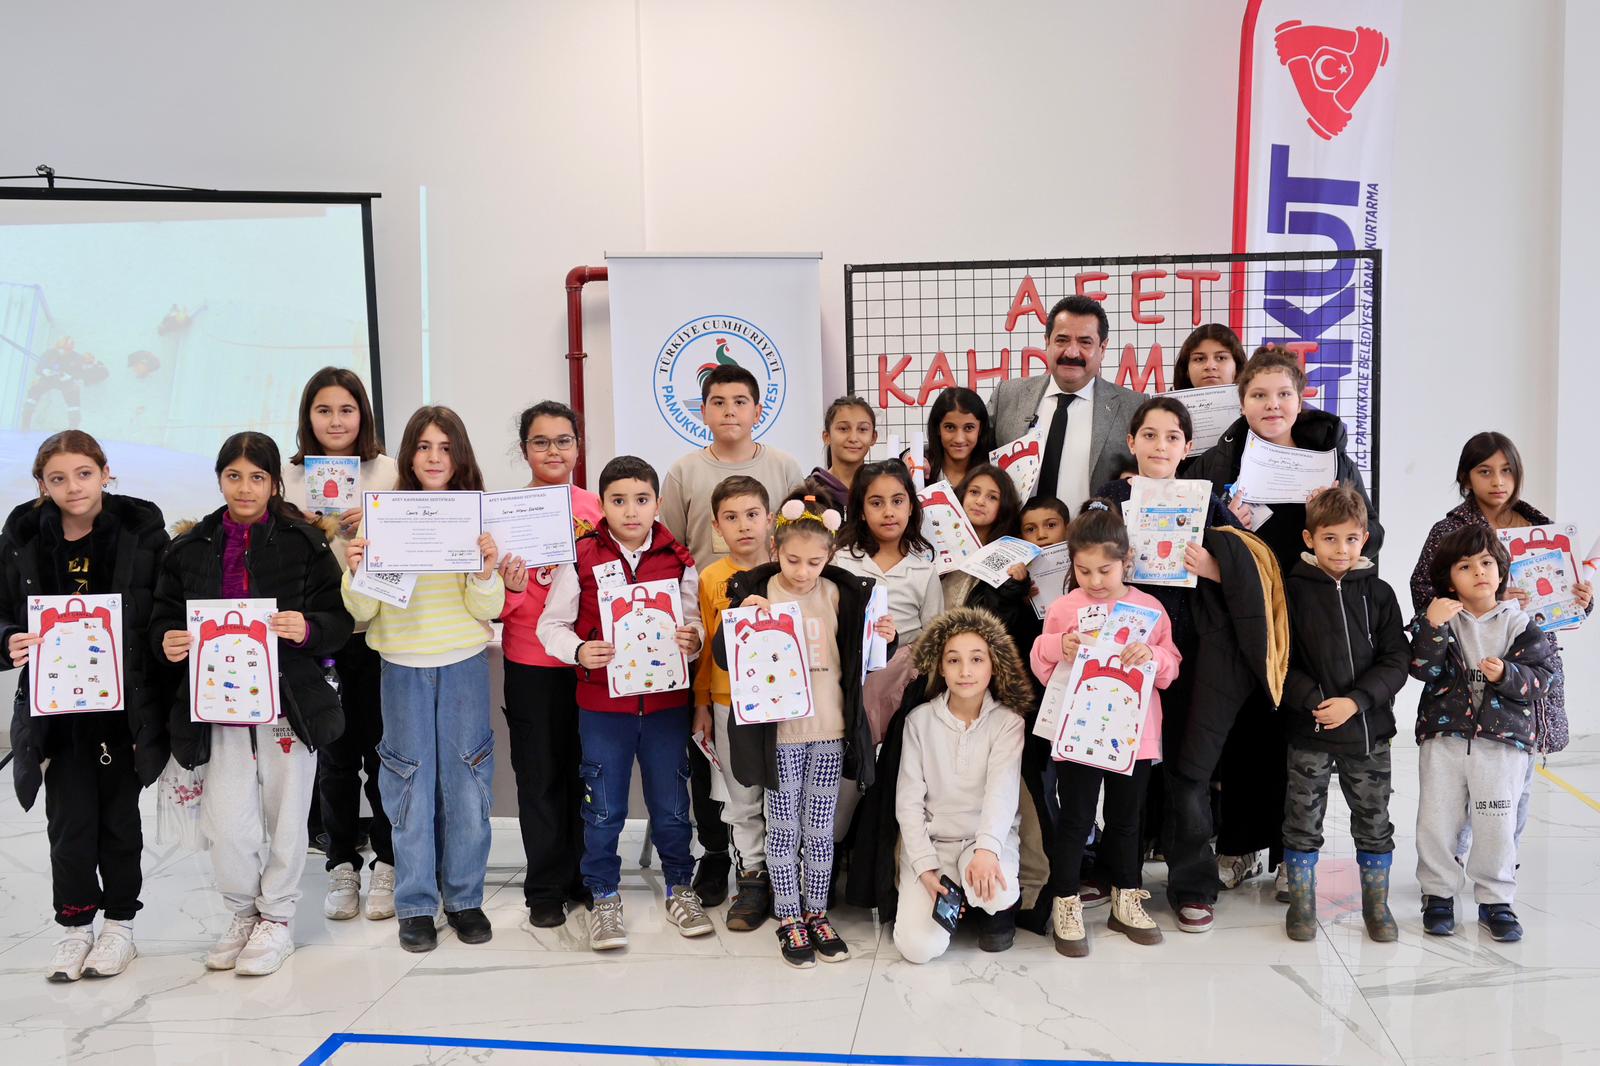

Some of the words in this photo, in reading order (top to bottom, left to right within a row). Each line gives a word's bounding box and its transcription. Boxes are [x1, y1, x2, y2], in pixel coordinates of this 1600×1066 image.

[1364, 183, 1379, 250] KURTARMA
[1004, 269, 1221, 332] AFET
[1363, 258, 1374, 298] ARAM
[659, 325, 701, 375] TÜRKİYE
[702, 319, 782, 373] CUMHURİYETİ
[662, 385, 714, 442] PAMUKKAL
[1356, 372, 1370, 446] PAMUKKALE
[1475, 800, 1487, 810] LOS
